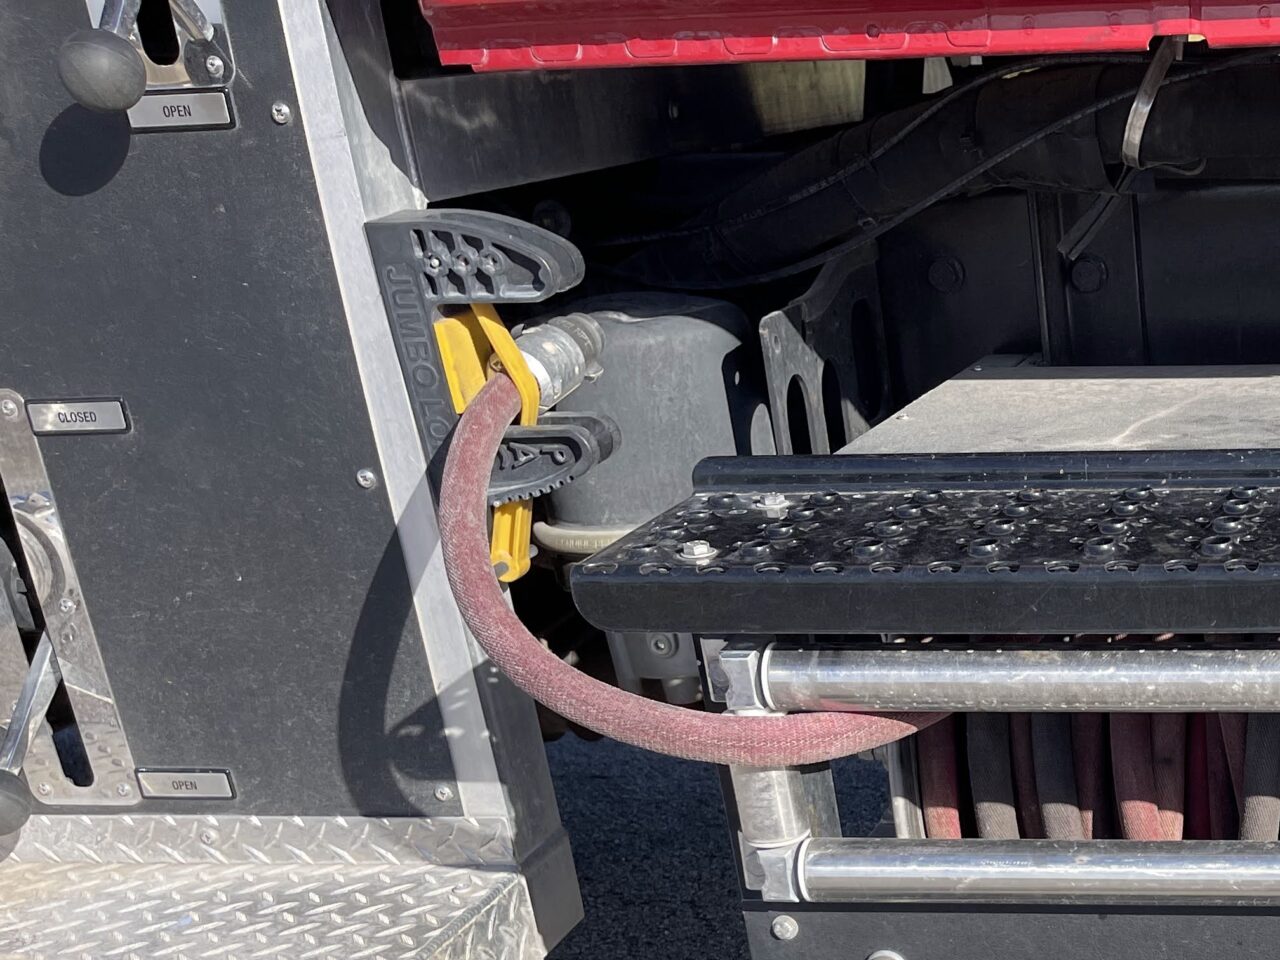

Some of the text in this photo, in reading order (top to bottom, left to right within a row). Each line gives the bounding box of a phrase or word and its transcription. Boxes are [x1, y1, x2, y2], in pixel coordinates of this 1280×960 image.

[162, 105, 192, 118] OPEN
[384, 264, 450, 447] JUMBO LO
[57, 411, 97, 423] CLOSED
[171, 780, 198, 791] OPEN
